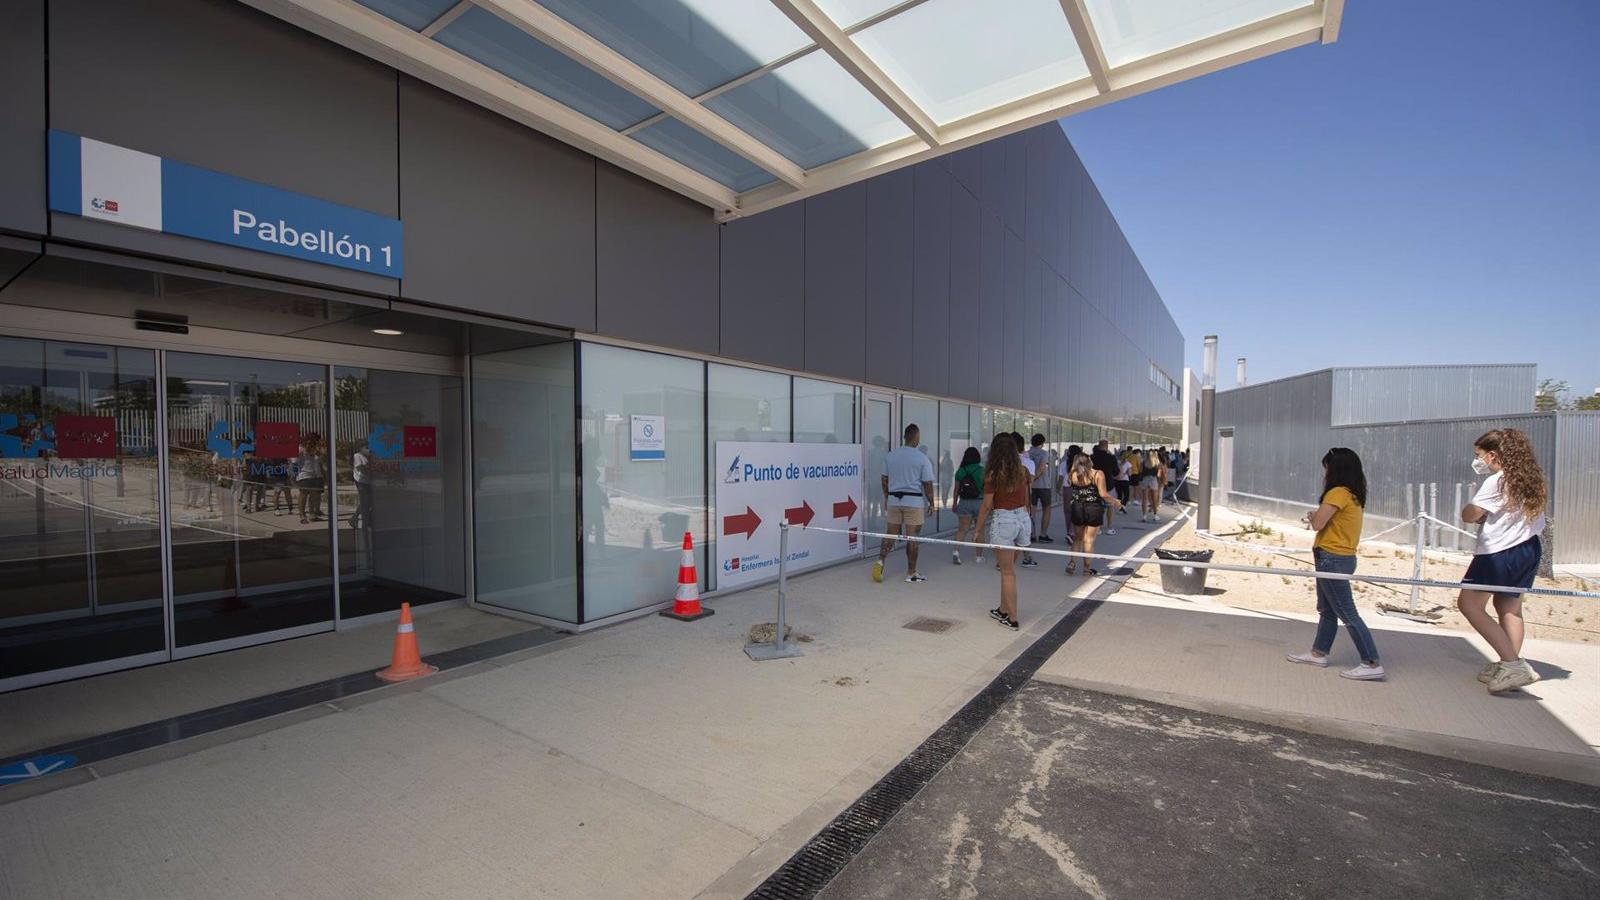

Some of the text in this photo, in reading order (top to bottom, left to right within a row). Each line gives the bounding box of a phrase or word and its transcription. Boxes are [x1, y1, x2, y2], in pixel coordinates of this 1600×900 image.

[233, 209, 392, 267] Pabellón 1
[207, 463, 301, 477] SaluMadrd
[744, 461, 858, 481] Punto de vacunación
[741, 550, 810, 572] Enfermera Isel Zendal
